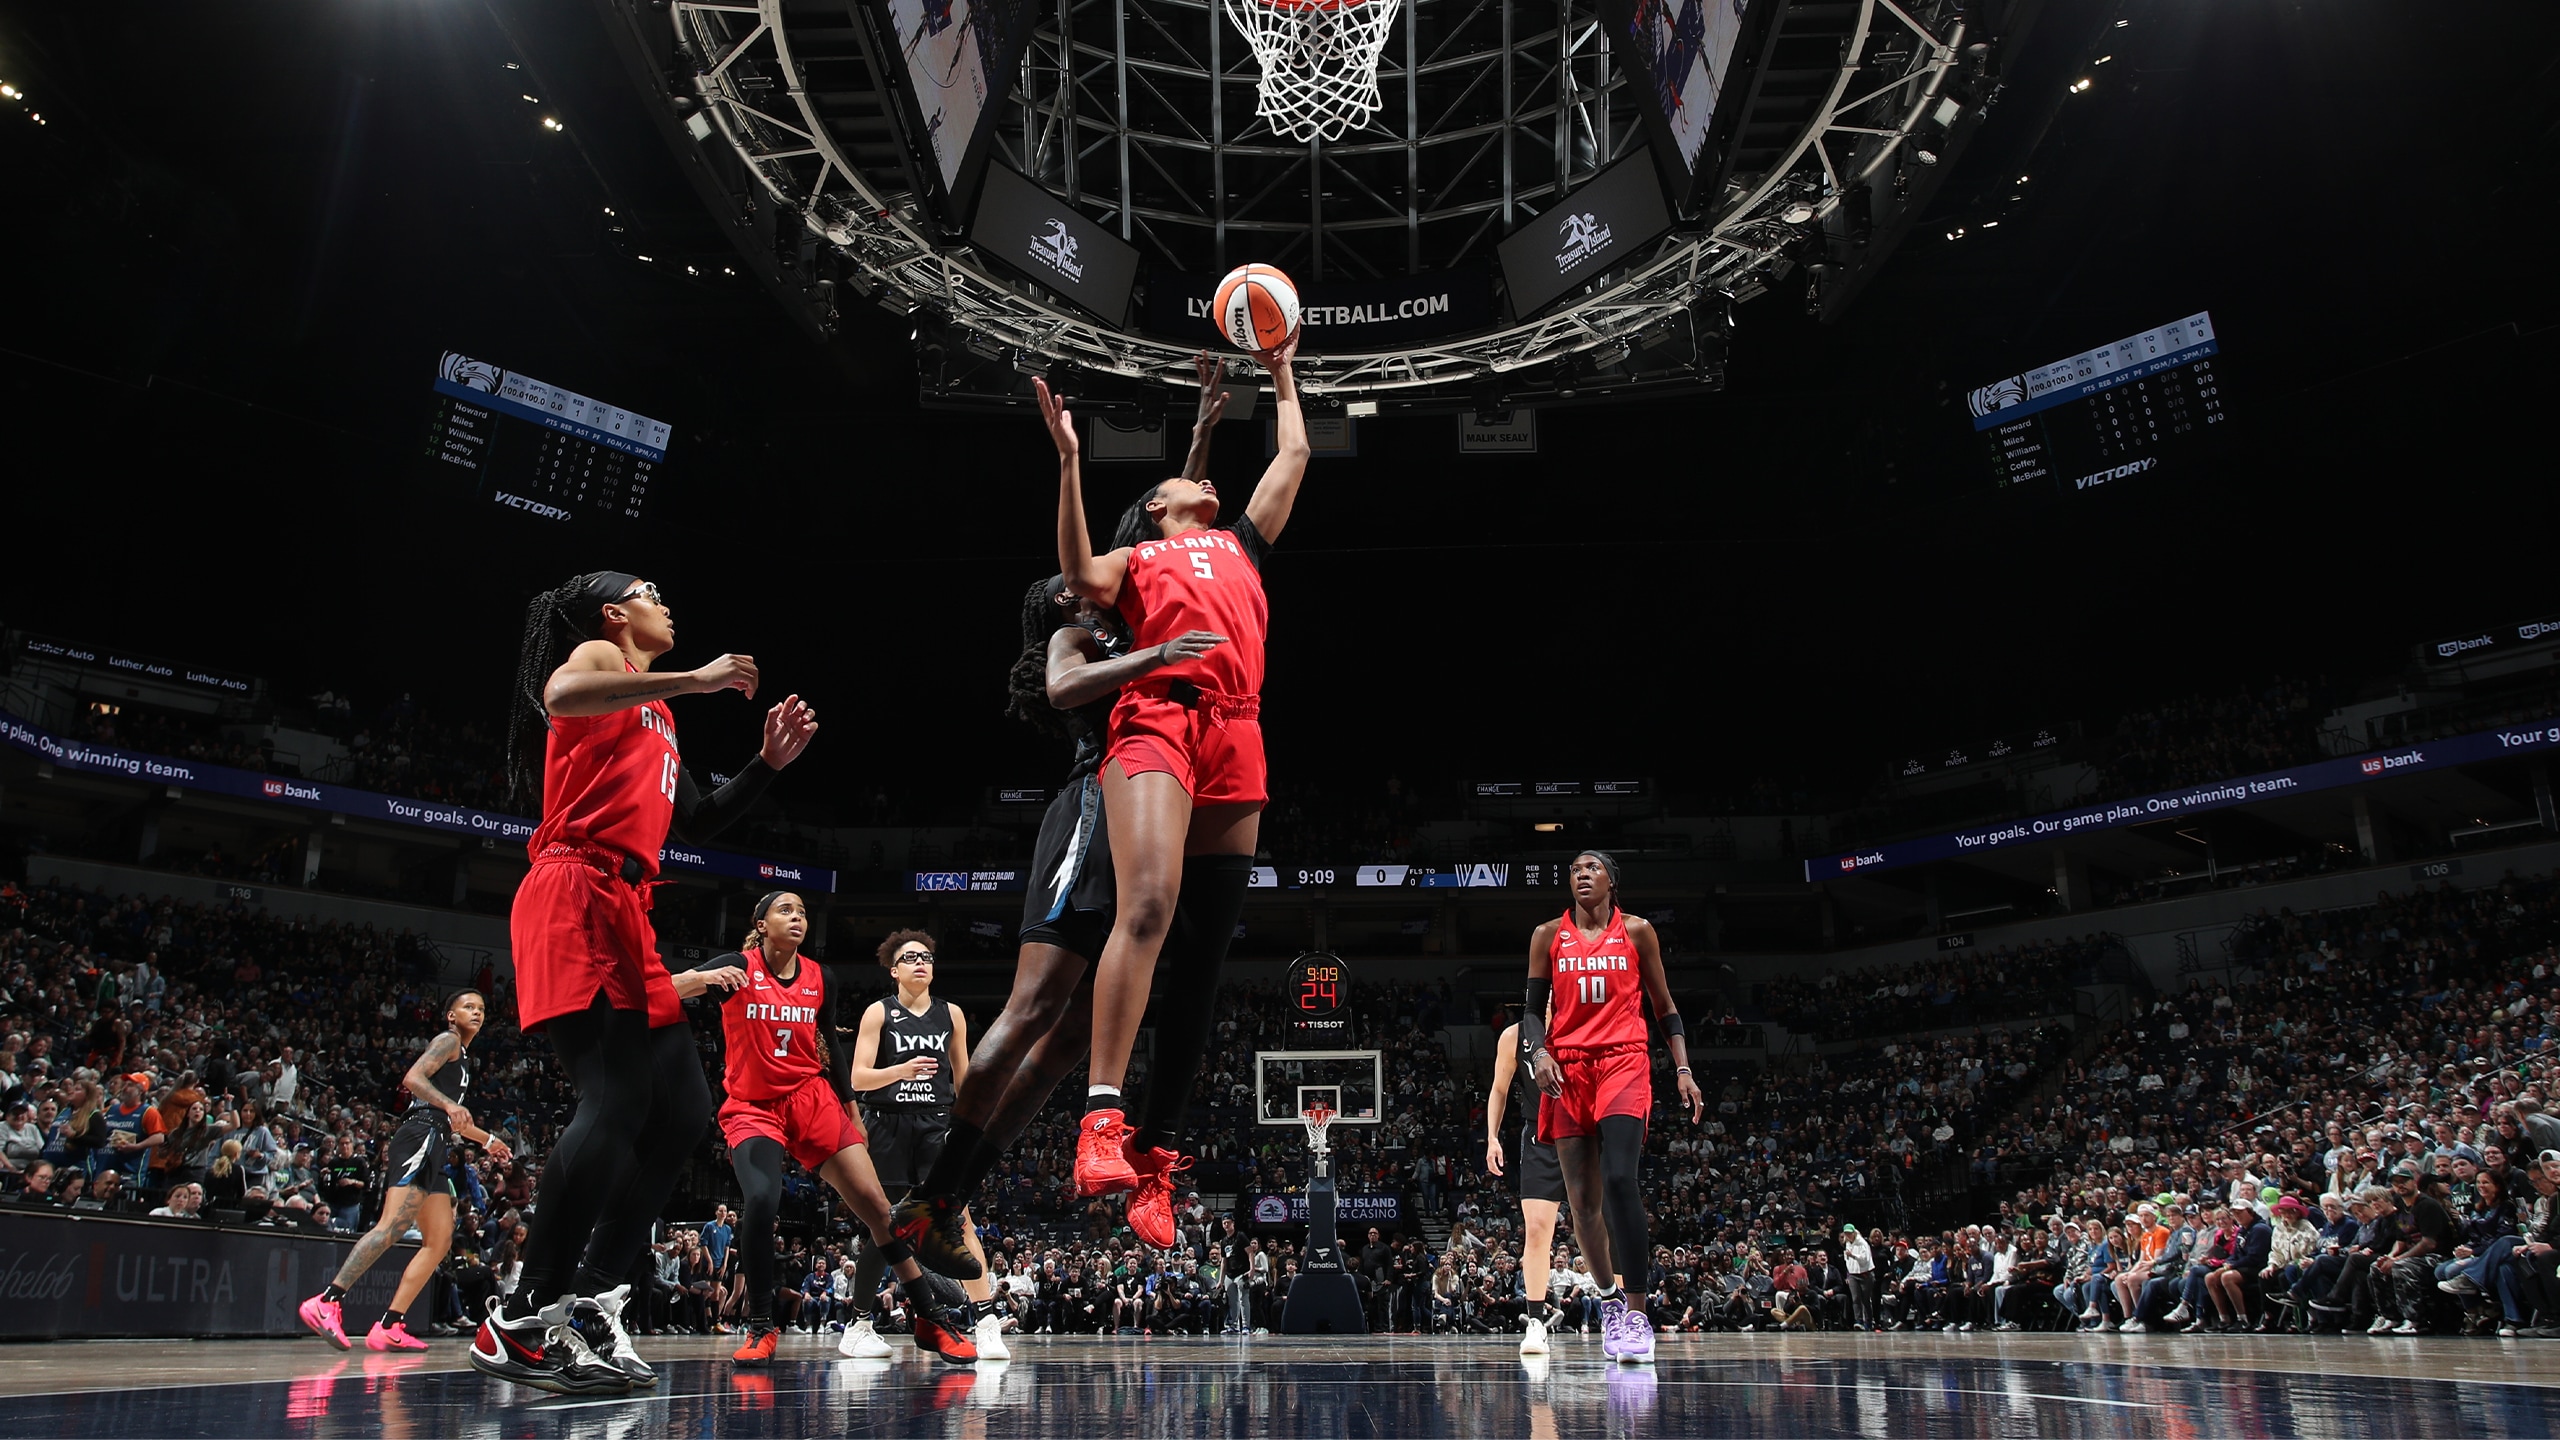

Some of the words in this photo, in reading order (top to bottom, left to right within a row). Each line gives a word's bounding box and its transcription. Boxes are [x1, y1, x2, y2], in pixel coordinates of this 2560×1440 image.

[1555, 244, 1585, 268] Treasure
[1589, 223, 1611, 248] Island
[1030, 234, 1058, 262] Treasure
[1062, 256, 1084, 278] Island
[2120, 342, 2133, 350] AST
[2079, 367, 2092, 376] 0.0
[2082, 385, 2096, 394] PTS
[2116, 374, 2128, 383] AST
[455, 402, 488, 419] Howard
[551, 402, 562, 410] 0.0
[451, 415, 474, 428] Miles
[546, 418, 558, 426] PTS
[560, 423, 572, 432] REB
[576, 428, 588, 436] AST
[594, 406, 606, 414] AST
[654, 426, 666, 434] BLK
[2000, 419, 2032, 436] Howard
[448, 427, 484, 445] Williams
[1466, 434, 1496, 442] MALIK
[1500, 434, 1528, 442] SEALY
[2003, 435, 2025, 448] Miles
[445, 440, 472, 455] Coffey
[2006, 444, 2041, 460] Williams
[441, 452, 477, 470] McBride
[2010, 458, 2036, 472] Coffey
[2012, 468, 2046, 484] McBride
[2076, 457, 2152, 490] VICTORY
[495, 490, 568, 520] VICTORY
[1140, 536, 1240, 560] ATLANTA
[1188, 552, 1214, 579] 5
[2540, 621, 2560, 633] ba
[2458, 635, 2493, 650] bank
[67, 648, 94, 661] Auto
[109, 656, 144, 671] Luther
[146, 664, 173, 676] Auto
[186, 671, 220, 685] Luther
[222, 678, 247, 691] Auto
[10, 724, 37, 747] plan.
[40, 736, 63, 756] One
[68, 748, 140, 774] winning
[145, 760, 194, 780] team.
[2362, 760, 2381, 772] us
[2384, 751, 2424, 768] bank
[2497, 728, 2542, 747] Your
[661, 752, 677, 804] 15
[265, 781, 282, 794] us
[285, 783, 320, 800] bank
[388, 800, 420, 818] Your
[424, 808, 468, 826] goals.
[472, 814, 500, 830] Our
[1841, 858, 1854, 868] us
[1856, 852, 1883, 866] bank
[1956, 834, 1986, 848] Your
[1990, 826, 2030, 844] goals.
[2033, 820, 2060, 834] Our
[2062, 812, 2103, 831] game
[2107, 805, 2144, 824] plan.
[2147, 798, 2179, 812] One
[2183, 784, 2246, 806] winning
[2250, 776, 2297, 793] team.
[670, 850, 705, 865] team.
[760, 865, 773, 876] us
[775, 866, 800, 880] bank
[2424, 864, 2448, 876] 106
[916, 872, 968, 891] KFAN
[972, 872, 996, 880] SPORTS
[996, 872, 1015, 880] RADIO
[1298, 870, 1335, 884] 9:09
[1376, 869, 1386, 883] 0
[1410, 878, 1416, 886] 0
[1430, 878, 1434, 886] 5
[971, 882, 980, 890] FM
[981, 882, 997, 890] 100.3
[1946, 936, 1964, 948] 104
[683, 948, 700, 958] 138
[1558, 956, 1628, 972] ATLANTA
[1308, 968, 1338, 981] 9:09
[1302, 983, 1336, 1008] 24
[1578, 976, 1605, 1004] 10
[746, 1004, 816, 1023] ATLANTA
[889, 1031, 949, 1052] LYNX
[900, 1082, 932, 1092] MAYO
[896, 1093, 936, 1102] CLINIC
[1354, 1198, 1396, 1208] ISLAND
[1340, 1209, 1348, 1219] &
[1351, 1209, 1396, 1219] CASINO
[1308, 1261, 1338, 1269] Fanatics
[116, 1254, 234, 1302] ULTRA
[372, 1270, 402, 1287] WORT
